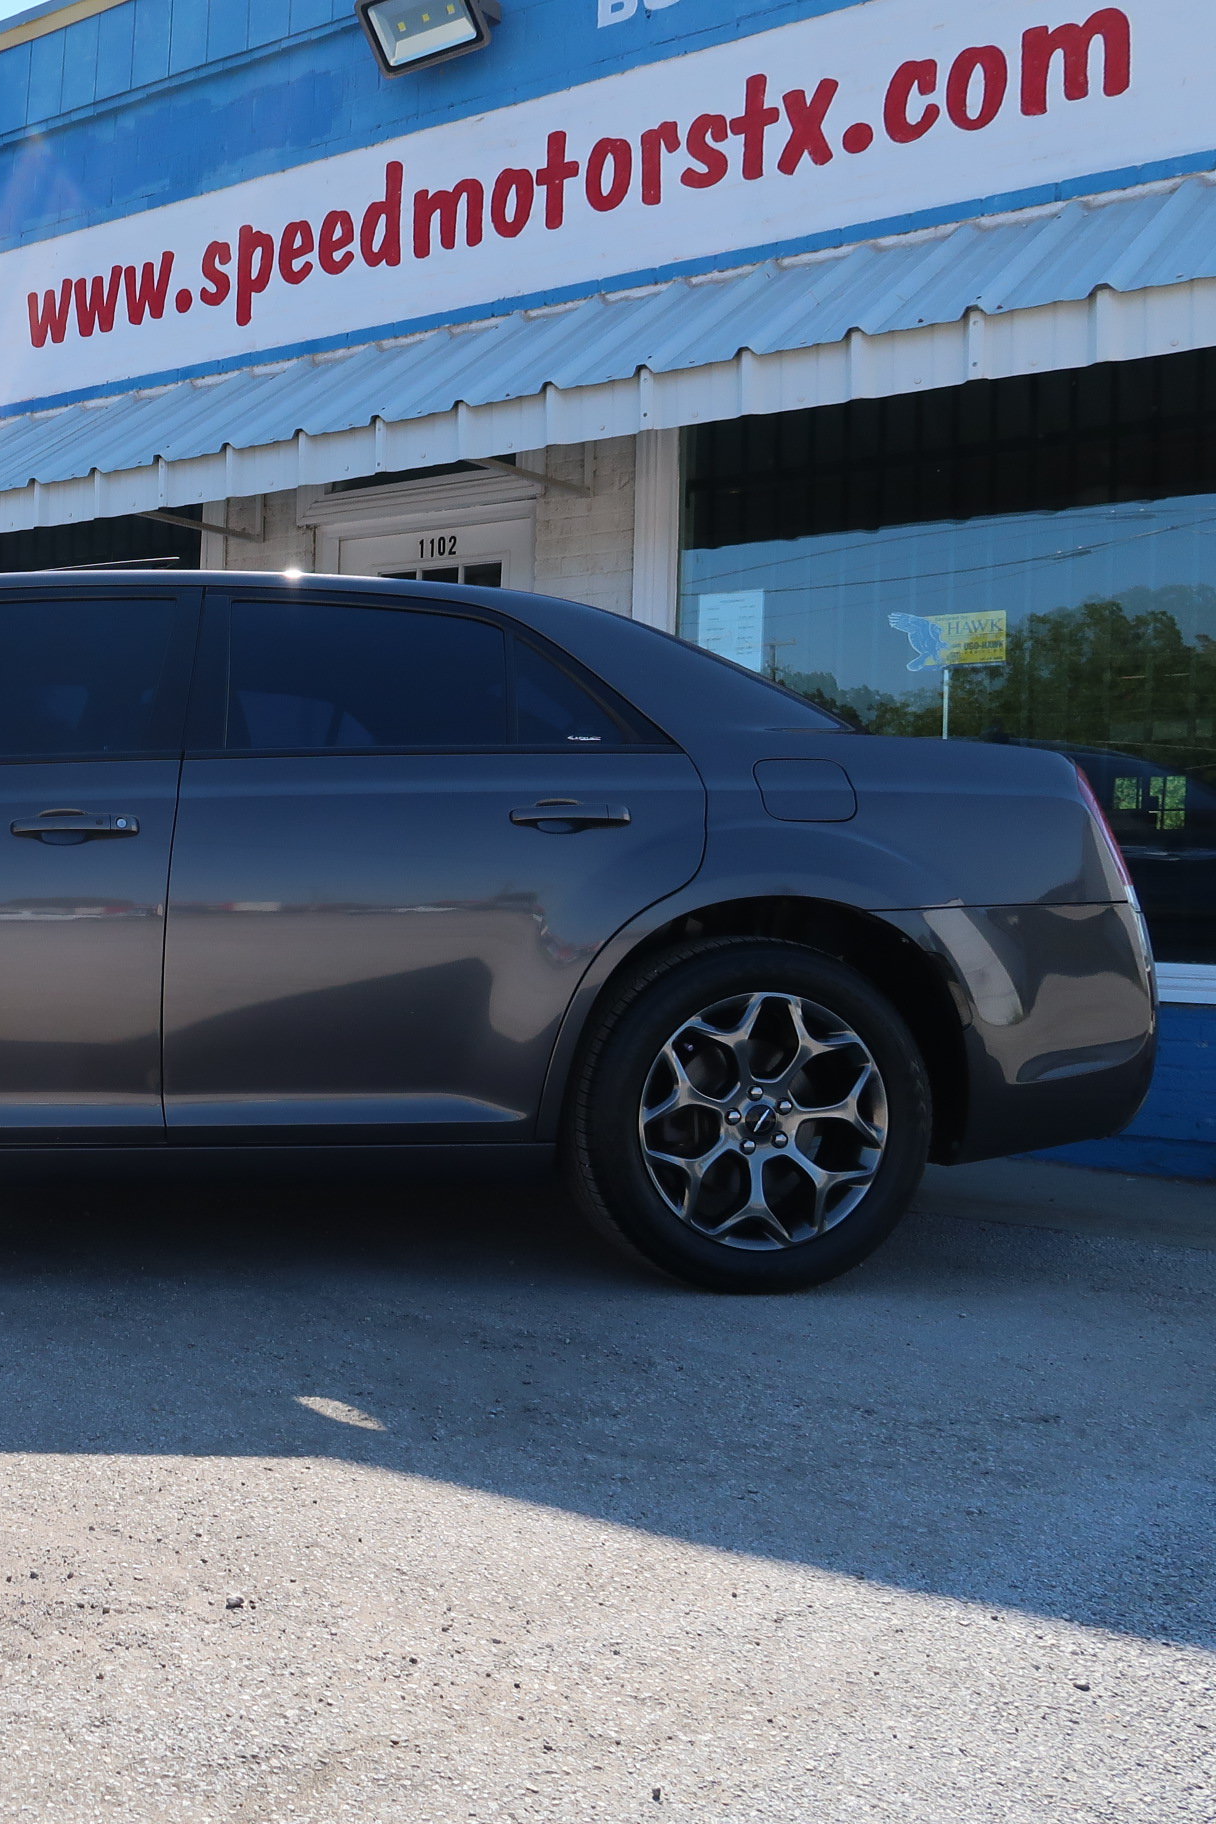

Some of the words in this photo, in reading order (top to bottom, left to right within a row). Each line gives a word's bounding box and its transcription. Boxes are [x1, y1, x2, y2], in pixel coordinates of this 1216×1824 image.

[27, 7, 1130, 349] www.speedmotorstx.com
[419, 535, 458, 559] 1102
[947, 618, 1004, 635] HAWK
